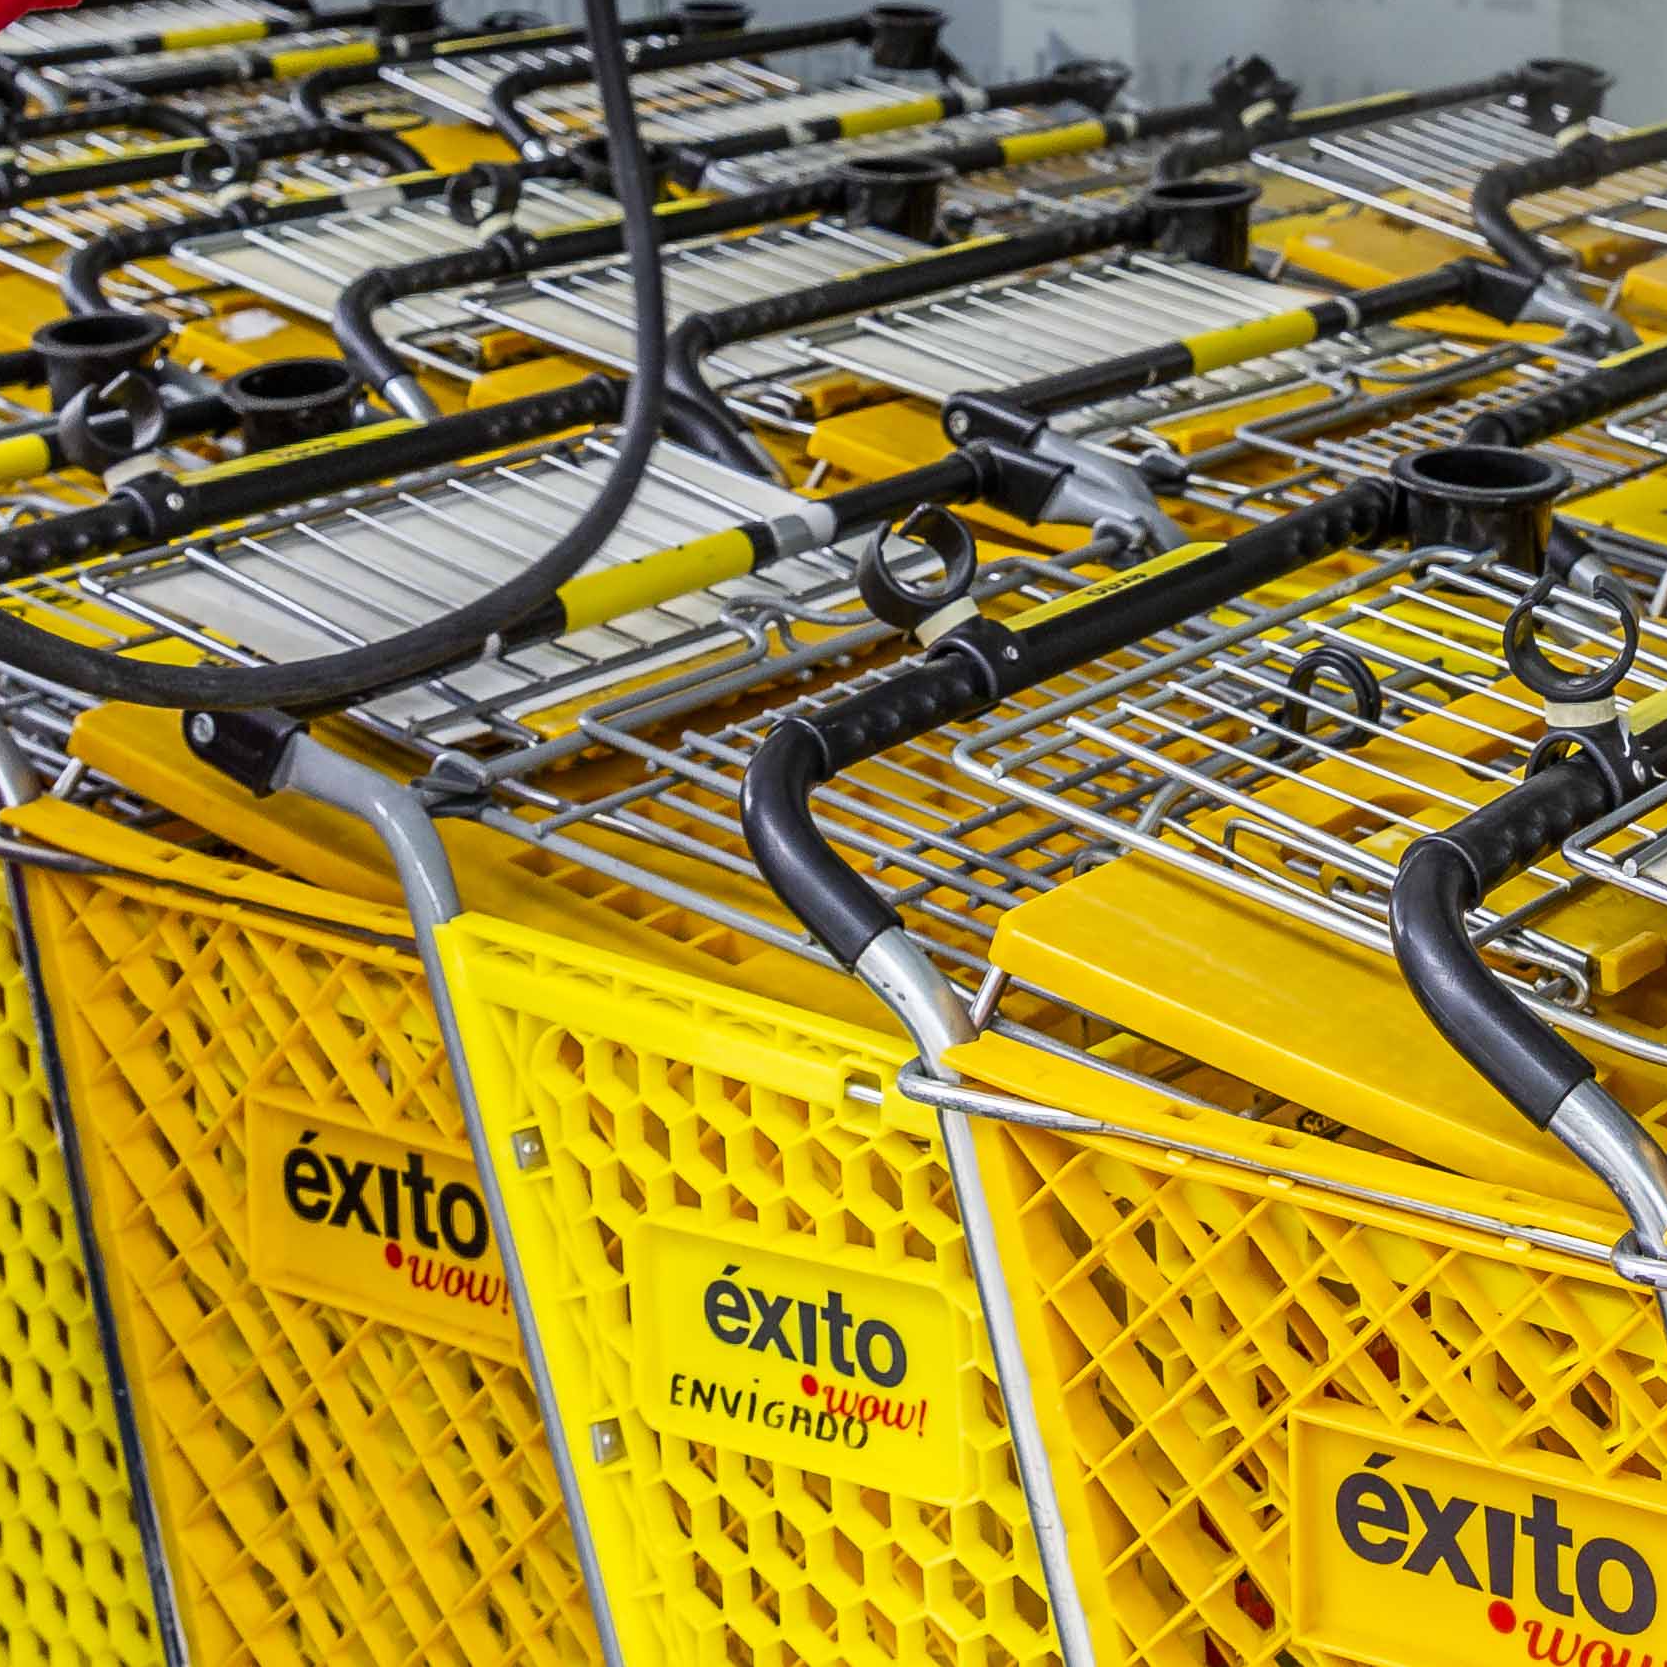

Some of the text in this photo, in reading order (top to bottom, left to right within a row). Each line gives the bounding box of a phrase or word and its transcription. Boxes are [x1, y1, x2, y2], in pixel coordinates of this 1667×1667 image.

[283, 1129, 490, 1262] éxito
[703, 1264, 908, 1389] éxito
[1334, 1451, 1658, 1637] éxito
